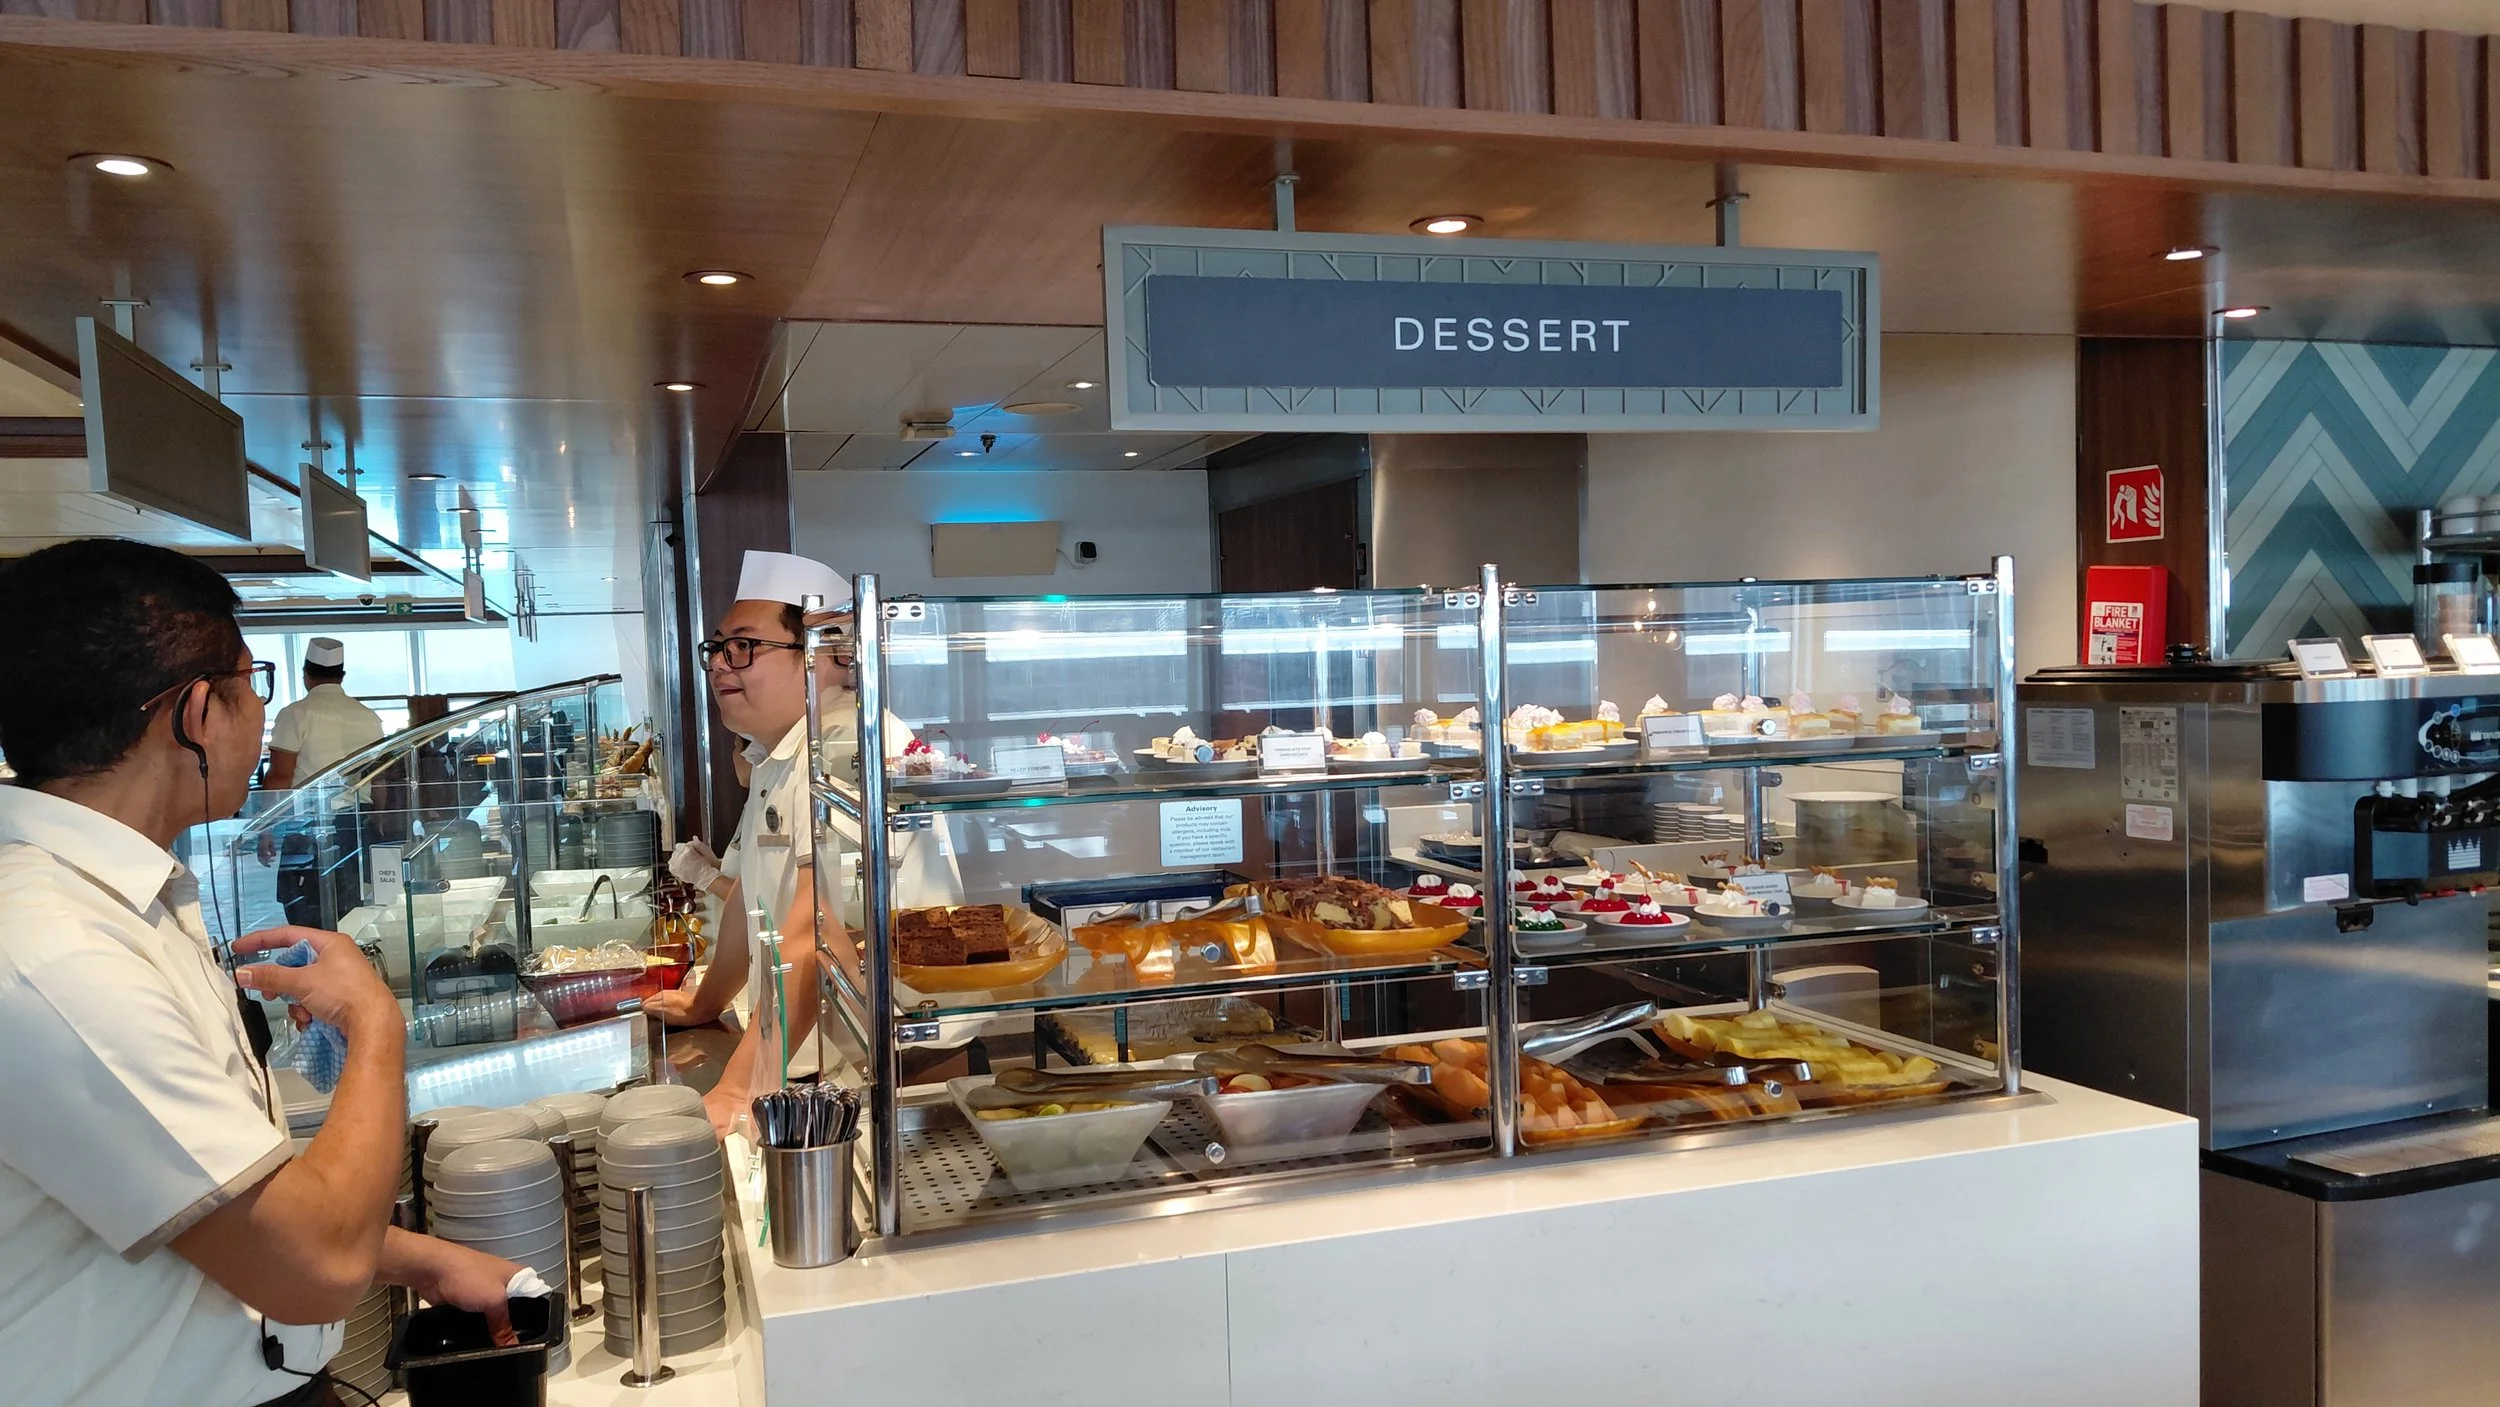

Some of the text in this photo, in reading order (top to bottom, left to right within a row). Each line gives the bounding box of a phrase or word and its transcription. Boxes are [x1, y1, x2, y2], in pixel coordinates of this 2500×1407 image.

[1394, 317, 1630, 352] DESSERT
[2105, 606, 2128, 618] FIRE
[2093, 617, 2139, 629] BLANKET
